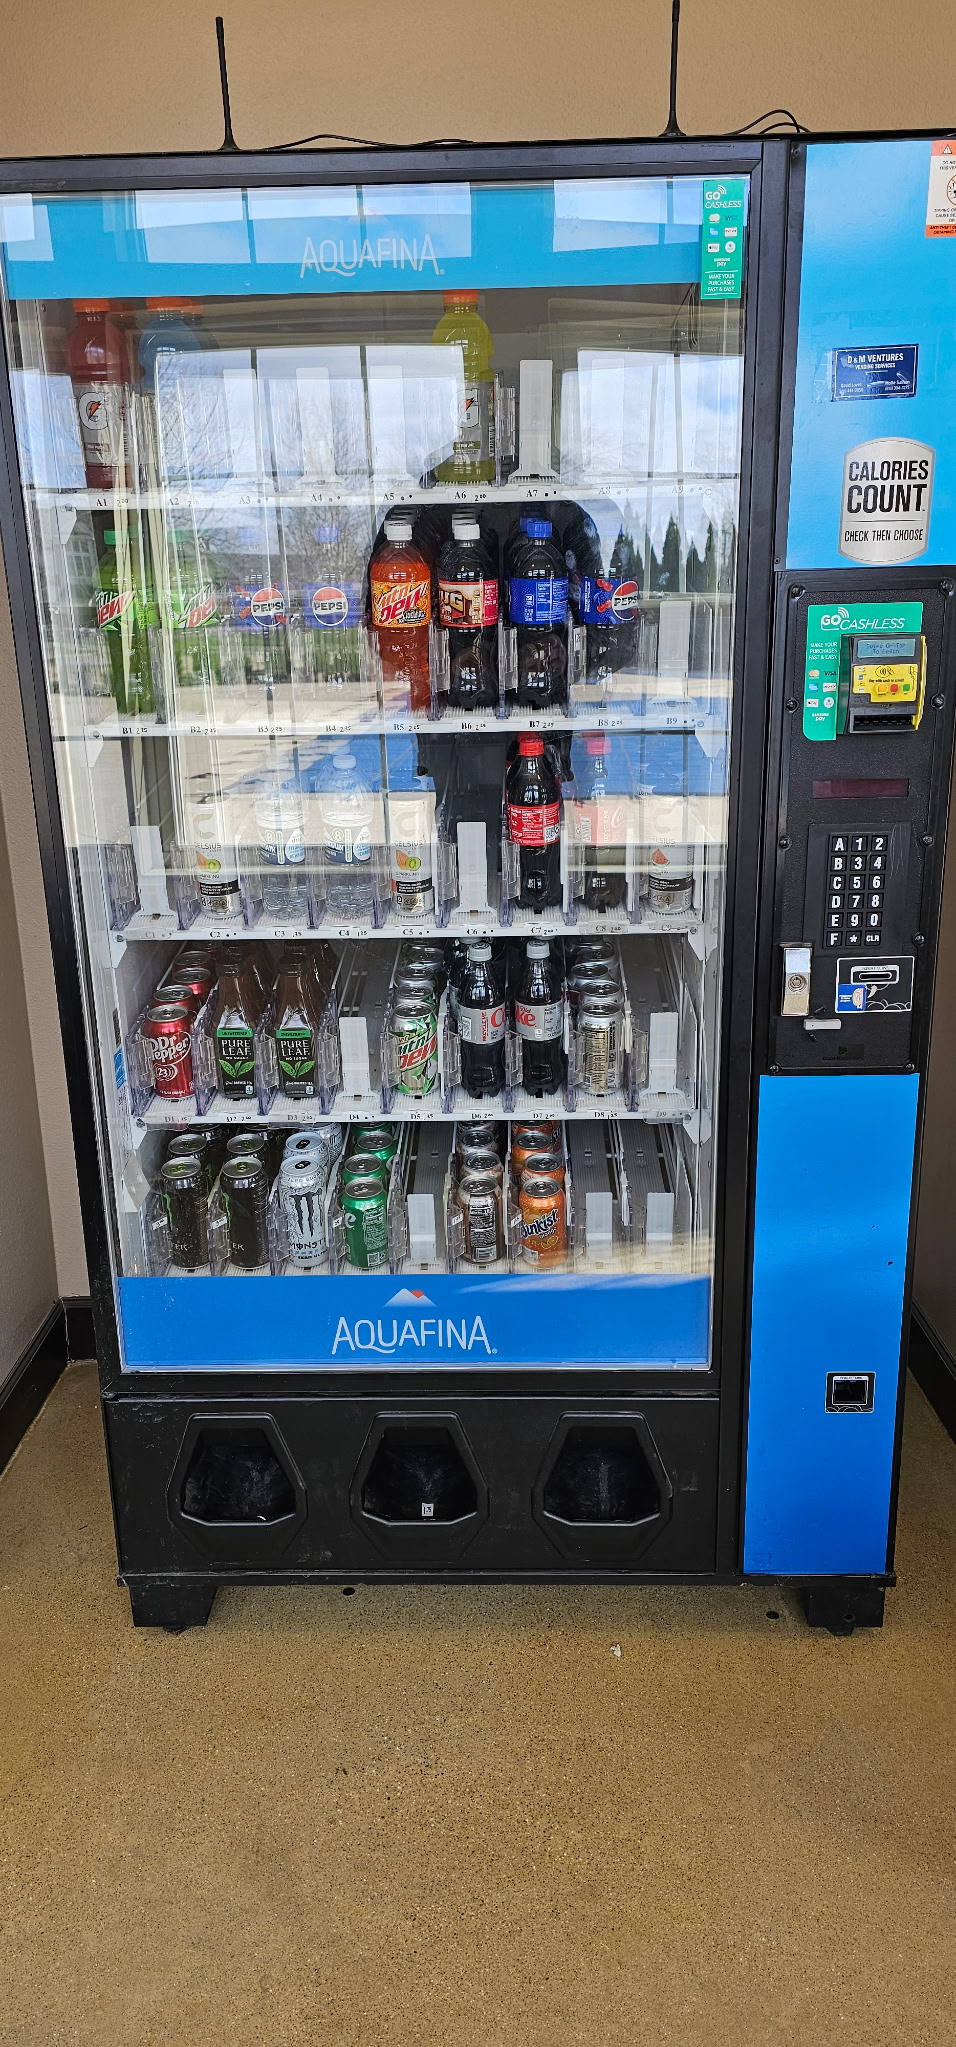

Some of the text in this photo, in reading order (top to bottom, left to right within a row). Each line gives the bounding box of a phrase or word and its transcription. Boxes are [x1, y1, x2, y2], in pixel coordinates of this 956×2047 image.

[705, 191, 720, 201] GO
[705, 201, 742, 209] CASHLESS
[300, 234, 440, 278] AQUAFINA
[847, 355, 853, 364] D
[858, 355, 866, 363] M
[868, 353, 904, 362] VENTURES
[848, 459, 929, 481] CALORIES
[526, 489, 538, 498] A7
[598, 487, 610, 495] A8
[672, 486, 684, 494] A9
[239, 496, 251, 504] A3
[310, 494, 322, 502] A4
[383, 493, 395, 501] A5
[454, 491, 466, 500] A6
[846, 484, 928, 514] COUNT
[96, 499, 108, 507] A1
[168, 498, 179, 506] A2
[844, 529, 923, 542] CHECK THEN CHOOSE
[614, 596, 638, 607] PEPS
[252, 603, 285, 614] PEPSI
[313, 603, 346, 613] PEPSI
[821, 614, 842, 626] GO
[840, 618, 906, 630] CASHLESS
[393, 723, 404, 731] B5
[461, 722, 472, 730] B6
[529, 720, 540, 728] B7
[122, 727, 132, 735] B1
[190, 725, 201, 734] B2
[394, 840, 424, 848] CELSIUS
[834, 837, 884, 852] A 1 2
[834, 856, 883, 870] B 3 4
[833, 875, 881, 889] C 5 6
[831, 894, 880, 908] D 7 8
[831, 913, 879, 927] E 9 0
[209, 931, 221, 939] C2
[338, 929, 350, 937] C4
[402, 928, 414, 936] C5
[830, 933, 880, 946] F CLR
[222, 1039, 251, 1047] PURE
[280, 1040, 309, 1048] PURE
[222, 1048, 251, 1056] LEAF
[281, 1048, 309, 1056] LEAF
[157, 1067, 168, 1078] 23
[332, 1315, 491, 1355] AQUAFINA
